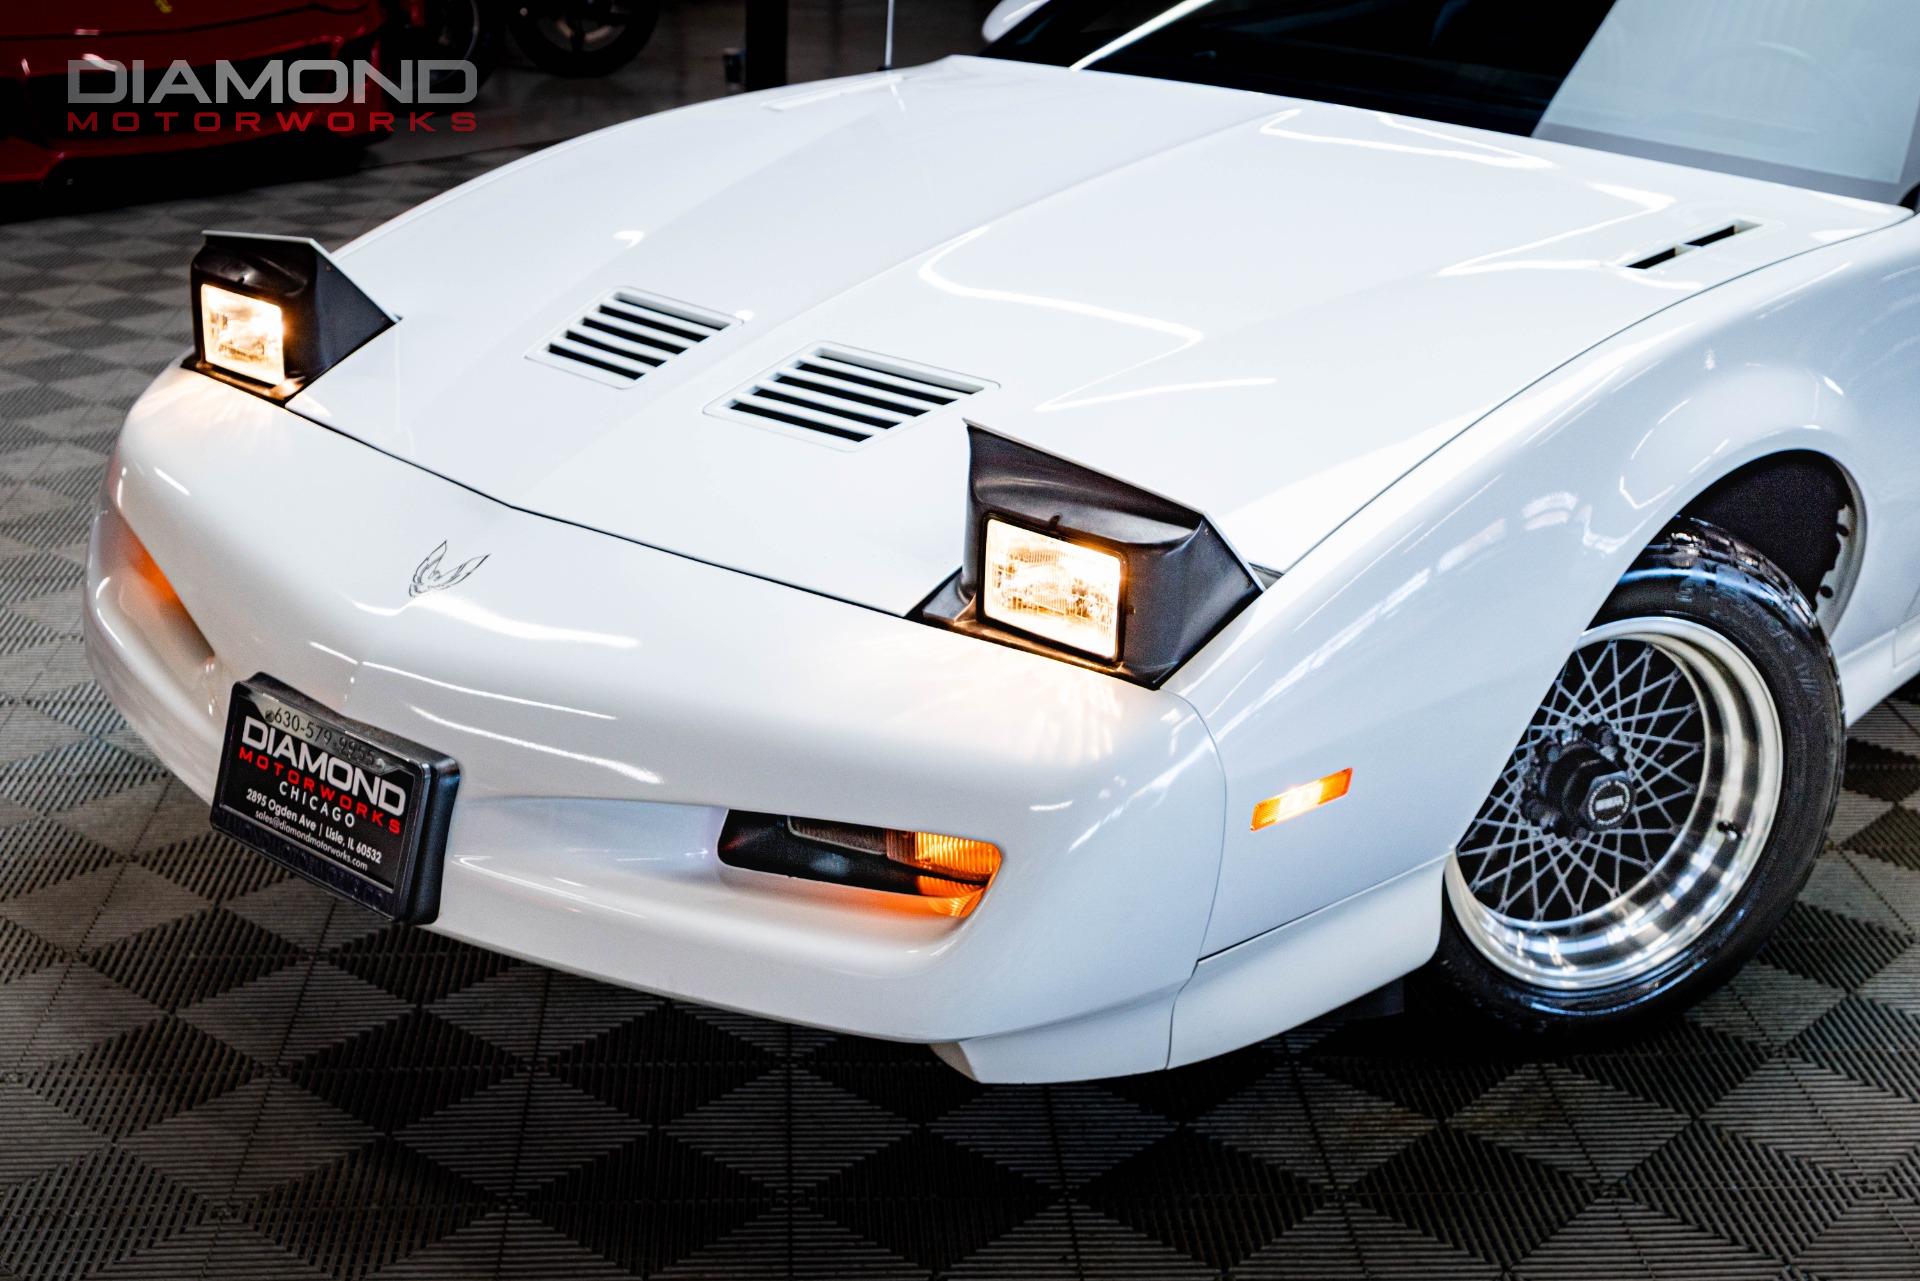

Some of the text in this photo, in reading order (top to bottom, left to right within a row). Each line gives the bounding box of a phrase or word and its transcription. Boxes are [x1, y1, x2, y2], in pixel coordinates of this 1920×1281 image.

[239, 746, 401, 834] MOTORWORKS
[241, 715, 407, 817] DIAMOND
[246, 788, 268, 807] 2895
[268, 798, 298, 822] Ogden
[298, 814, 317, 831] Ave
[325, 826, 345, 847] Lisle,
[347, 836, 355, 851] IL
[356, 841, 382, 864] 60532
[255, 809, 368, 871] sales@diamondmotorworks.com
[279, 781, 355, 828] CHICAGO
